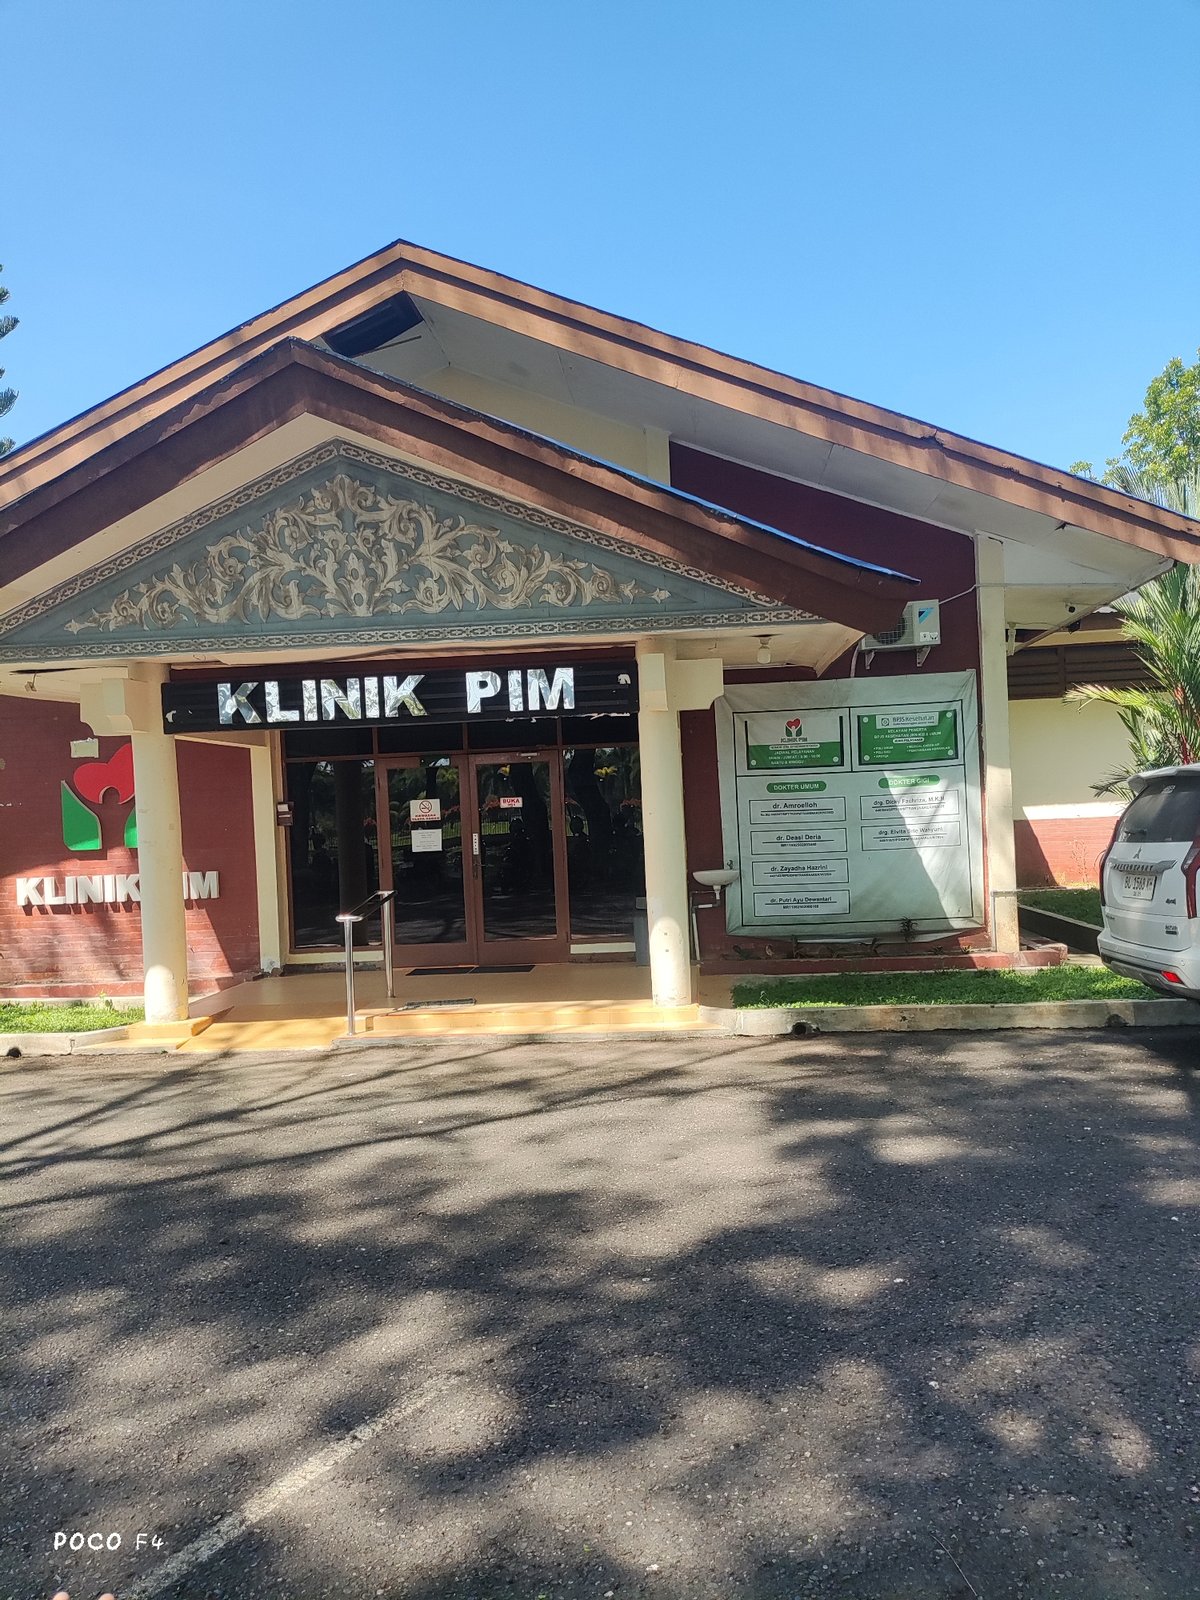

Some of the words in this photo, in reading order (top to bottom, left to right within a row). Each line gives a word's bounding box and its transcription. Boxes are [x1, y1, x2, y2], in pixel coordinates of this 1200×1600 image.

[217, 675, 429, 725] KLINIK
[465, 667, 575, 714] PIM
[15, 874, 141, 906] KLINIK
[182, 871, 220, 900] IM
